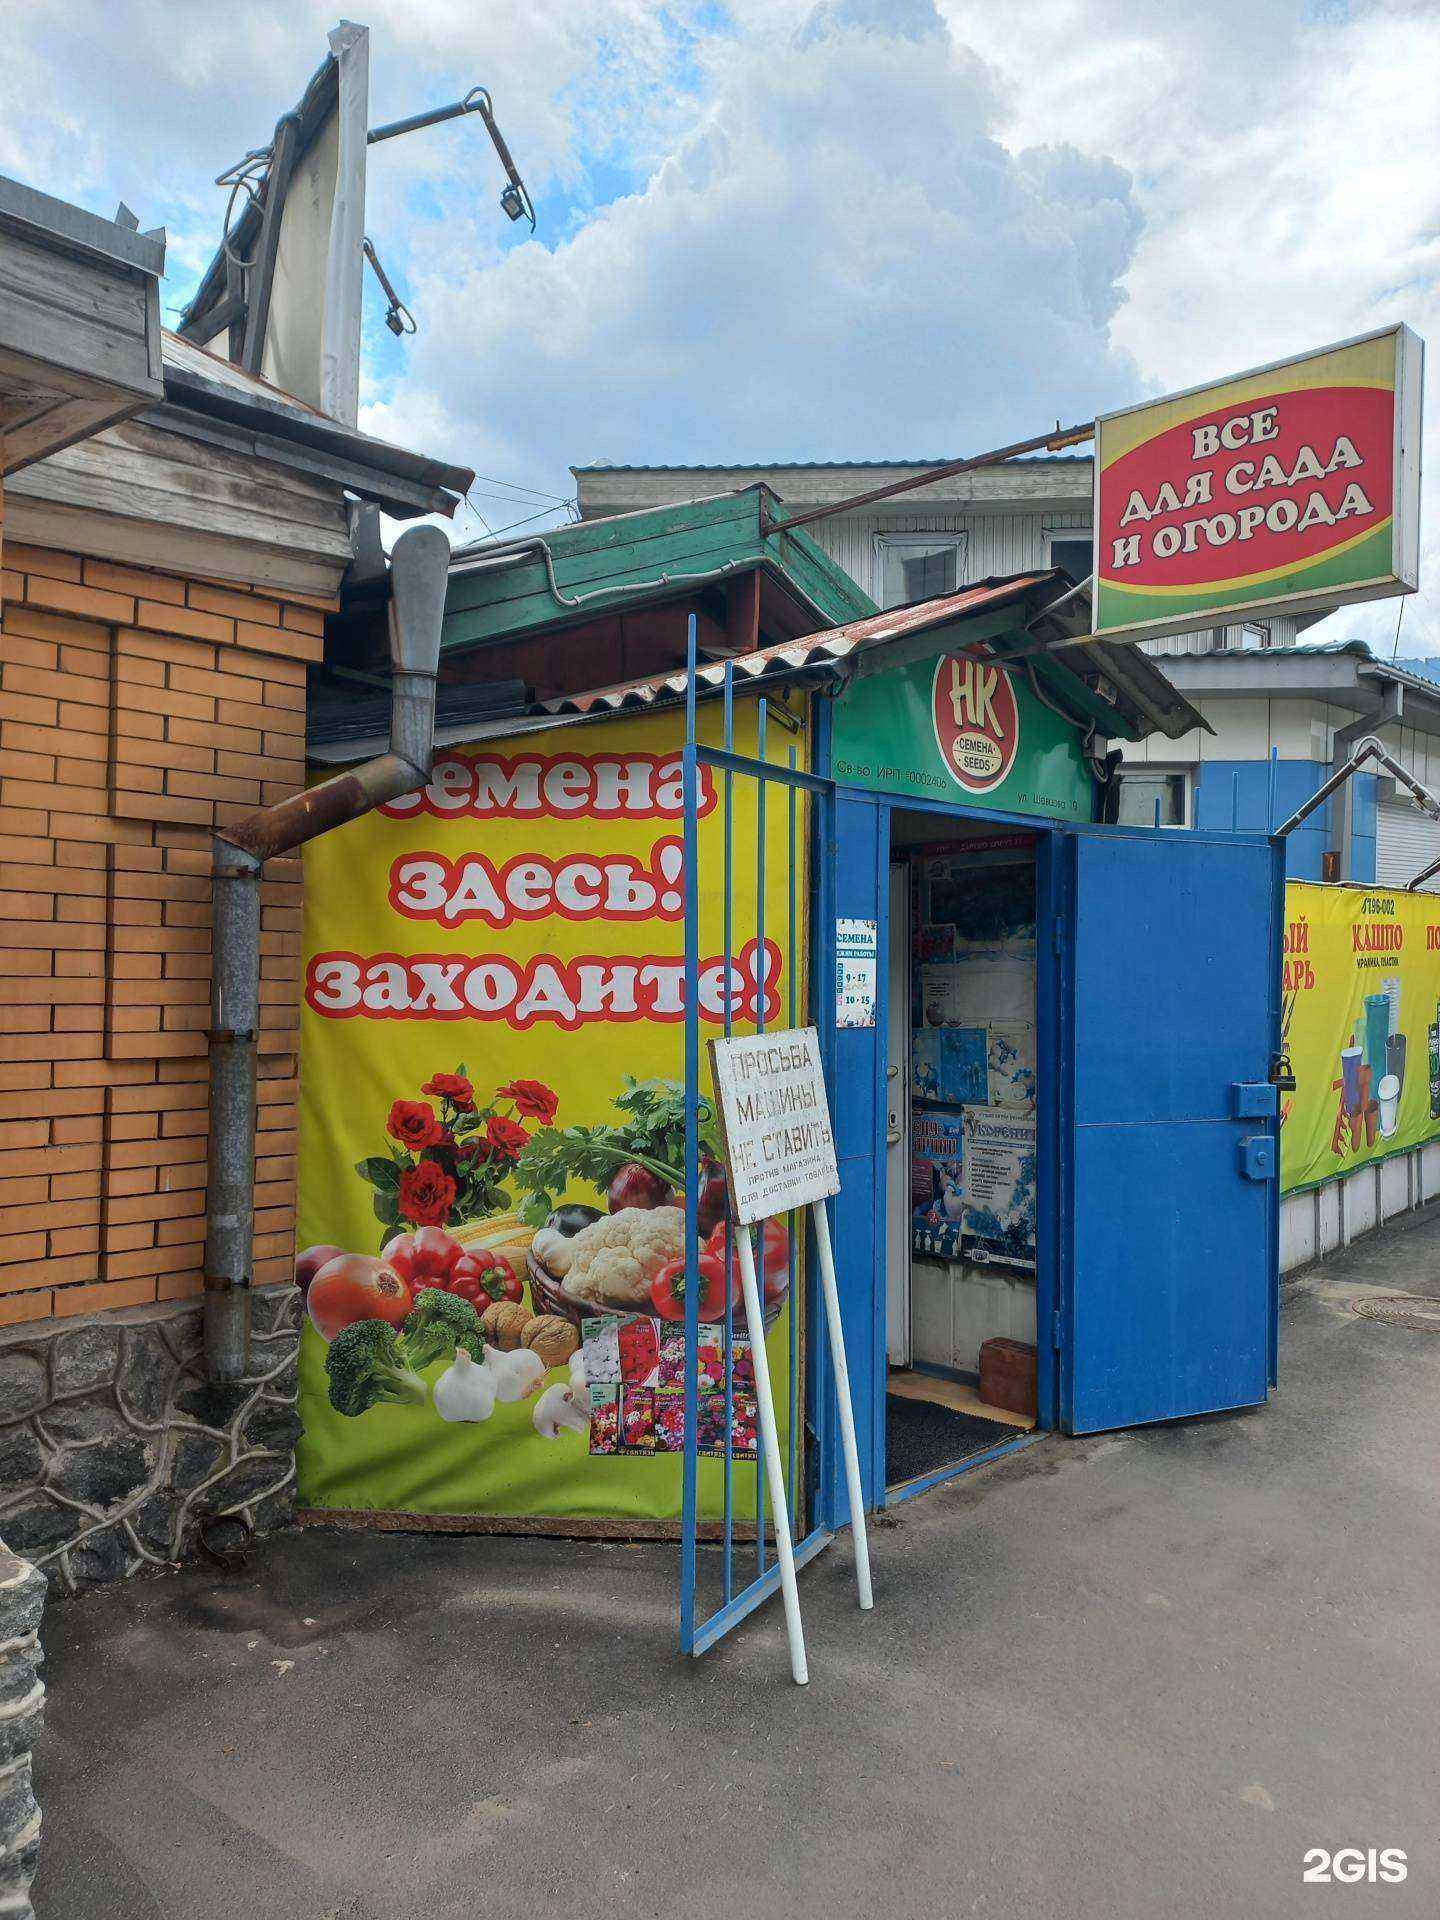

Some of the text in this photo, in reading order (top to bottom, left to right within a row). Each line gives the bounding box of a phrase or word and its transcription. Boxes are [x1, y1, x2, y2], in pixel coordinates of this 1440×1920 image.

[1191, 405, 1280, 460] ВСЕ
[1119, 435, 1364, 528] ДЛЯ САДА
[1111, 482, 1375, 569] И ОГОРОДА
[959, 737, 994, 755] СЕМЕНА
[963, 756, 991, 771] SEEDS
[384, 758, 711, 814] емена
[395, 841, 684, 923] здесь!
[837, 933, 873, 944] СЕМЕНА
[1352, 923, 1404, 952] КАШПО
[311, 944, 775, 1024] заходите!
[731, 1042, 813, 1081] ПРОСЬБА
[736, 1080, 818, 1125] МАШИНЫ
[762, 1121, 831, 1163] СТАВИТЬ
